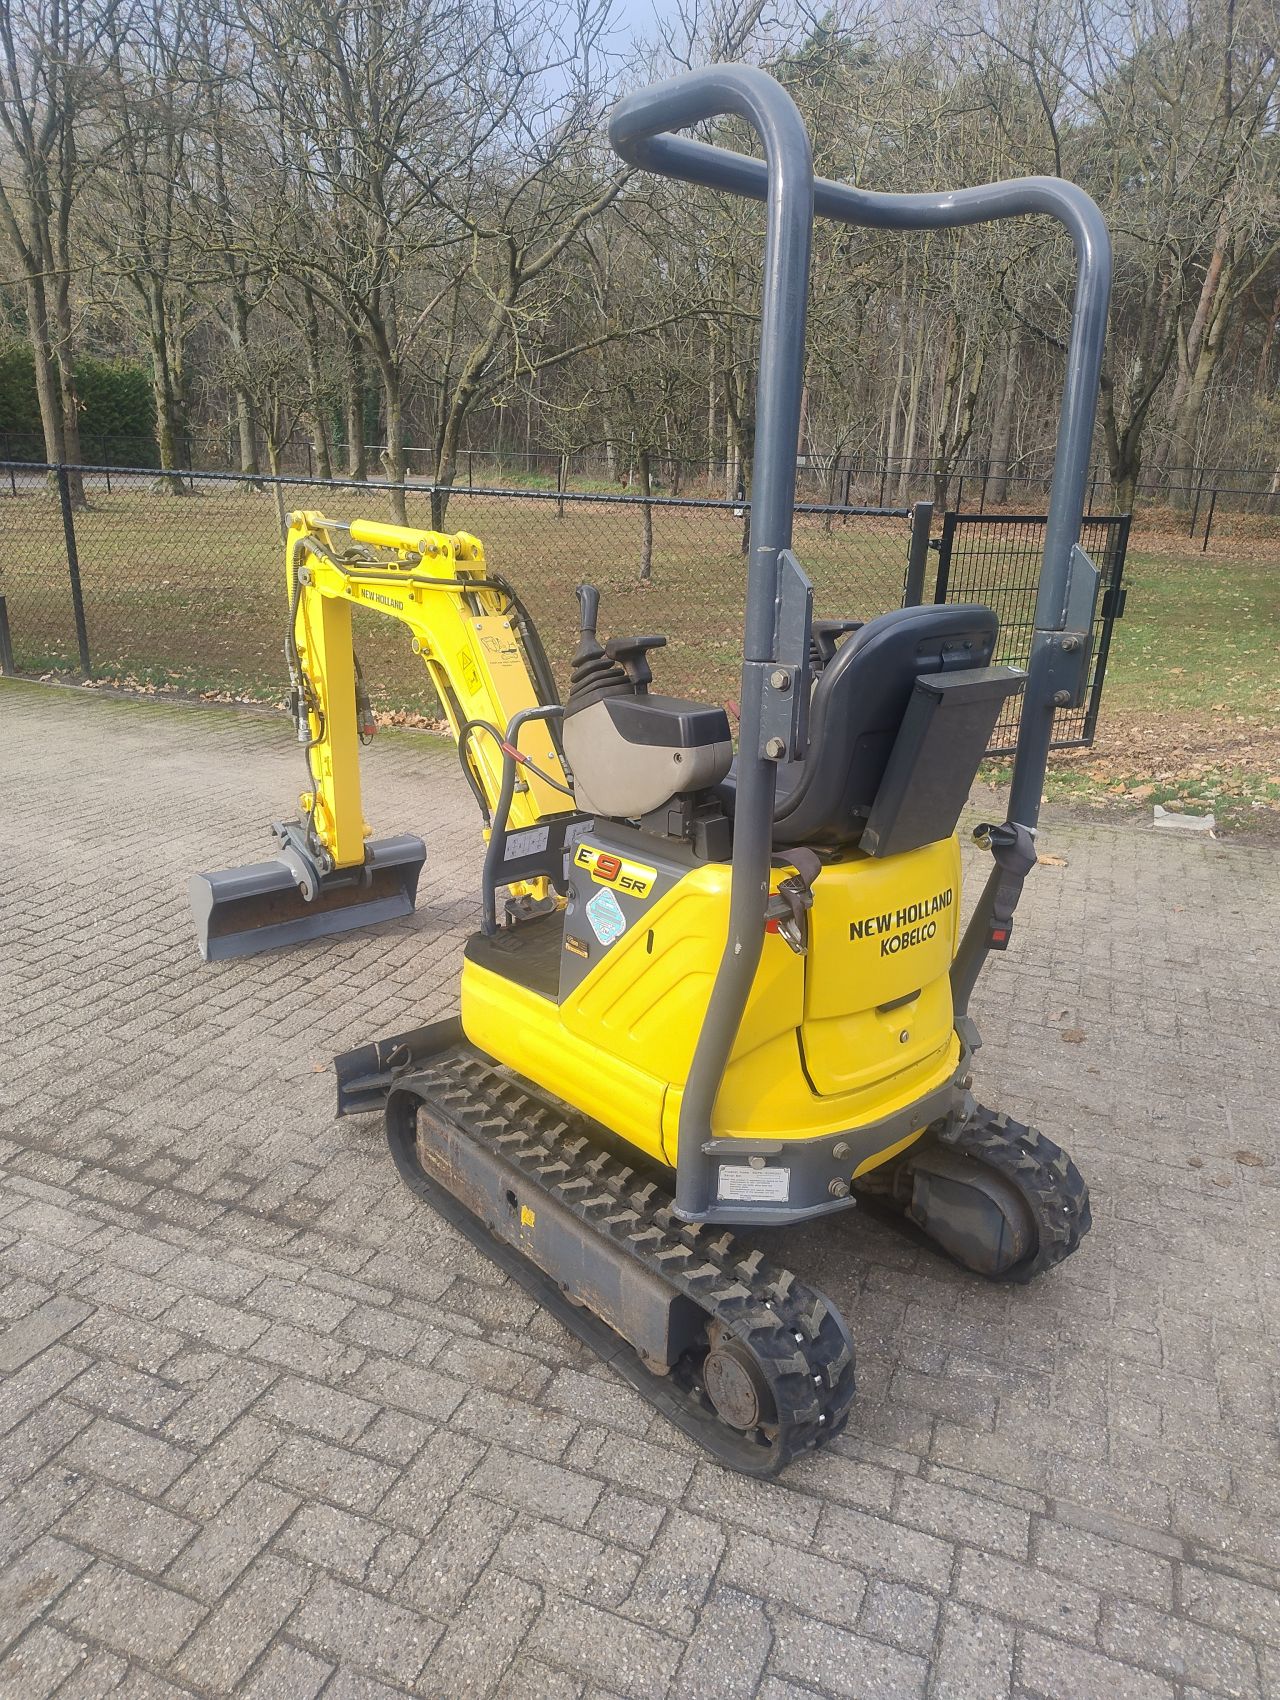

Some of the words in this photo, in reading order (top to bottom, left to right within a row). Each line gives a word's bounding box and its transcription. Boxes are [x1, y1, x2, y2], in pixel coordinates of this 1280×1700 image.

[361, 588, 375, 601] NEW
[375, 592, 404, 611] HOLLAND
[849, 912, 892, 941] NEW
[896, 888, 953, 928] HOLLAND
[880, 920, 937, 957] KOBELCO
